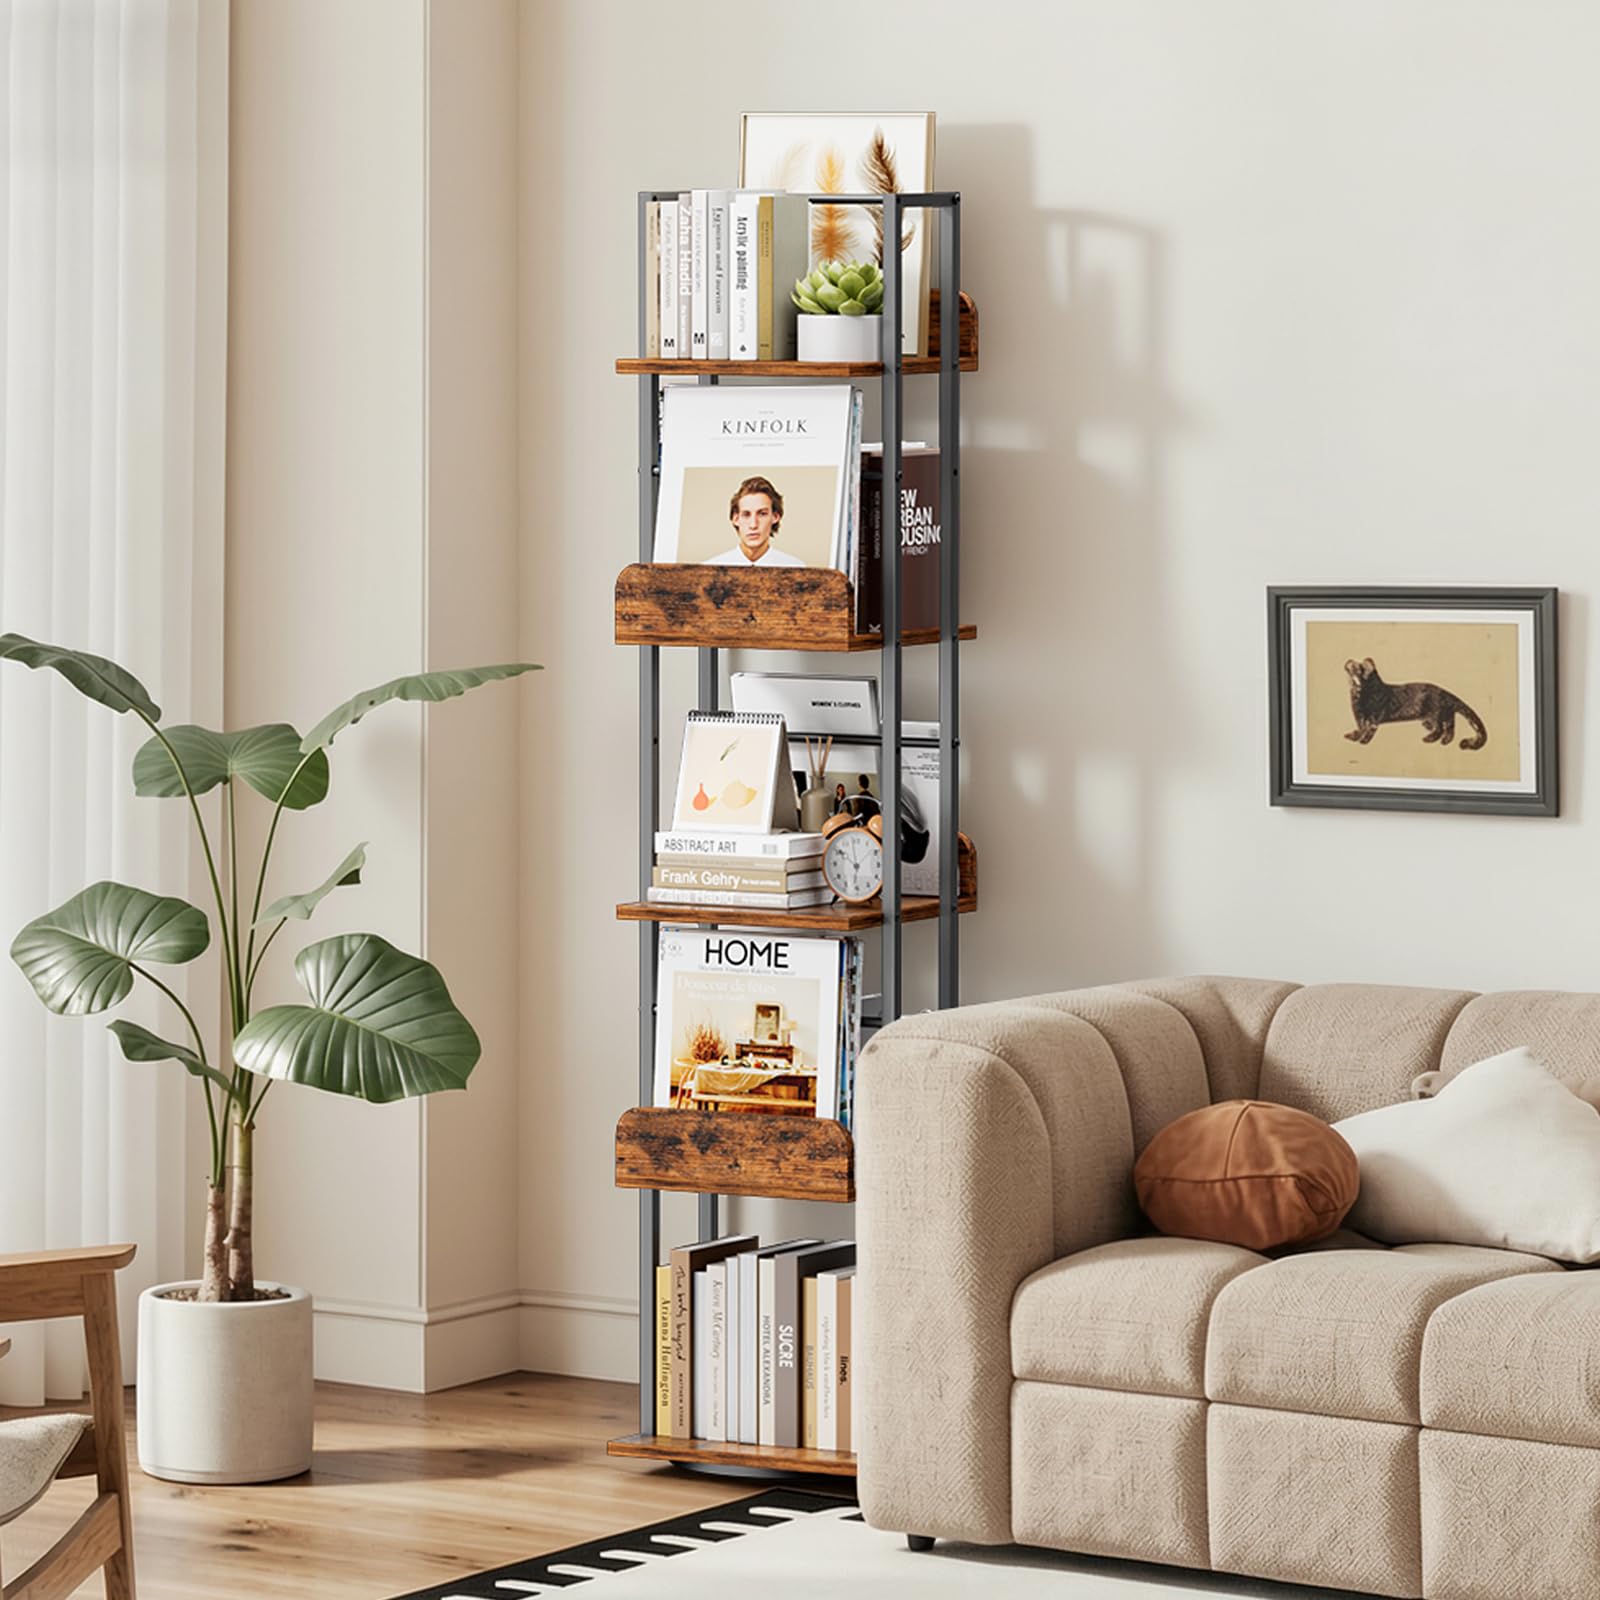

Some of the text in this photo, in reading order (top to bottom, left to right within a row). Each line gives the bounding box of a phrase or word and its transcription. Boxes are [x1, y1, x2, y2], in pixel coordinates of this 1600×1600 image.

[736, 216, 749, 247] Acrylic
[679, 250, 691, 295] Hadid
[735, 250, 749, 291] painting
[722, 419, 807, 434] KINFOLK
[901, 489, 917, 507] EW
[901, 506, 932, 527] RBAN
[664, 838, 737, 853] ABSTRACT ART
[660, 869, 698, 885] Frank
[700, 871, 741, 889] Gehry
[705, 938, 789, 968] HOME
[762, 1314, 772, 1405] HOTEL ALEXANDRA
[779, 1323, 794, 1367] SUCRE
[806, 1344, 814, 1390] BAUHAUS
[840, 1355, 849, 1386] lines.
